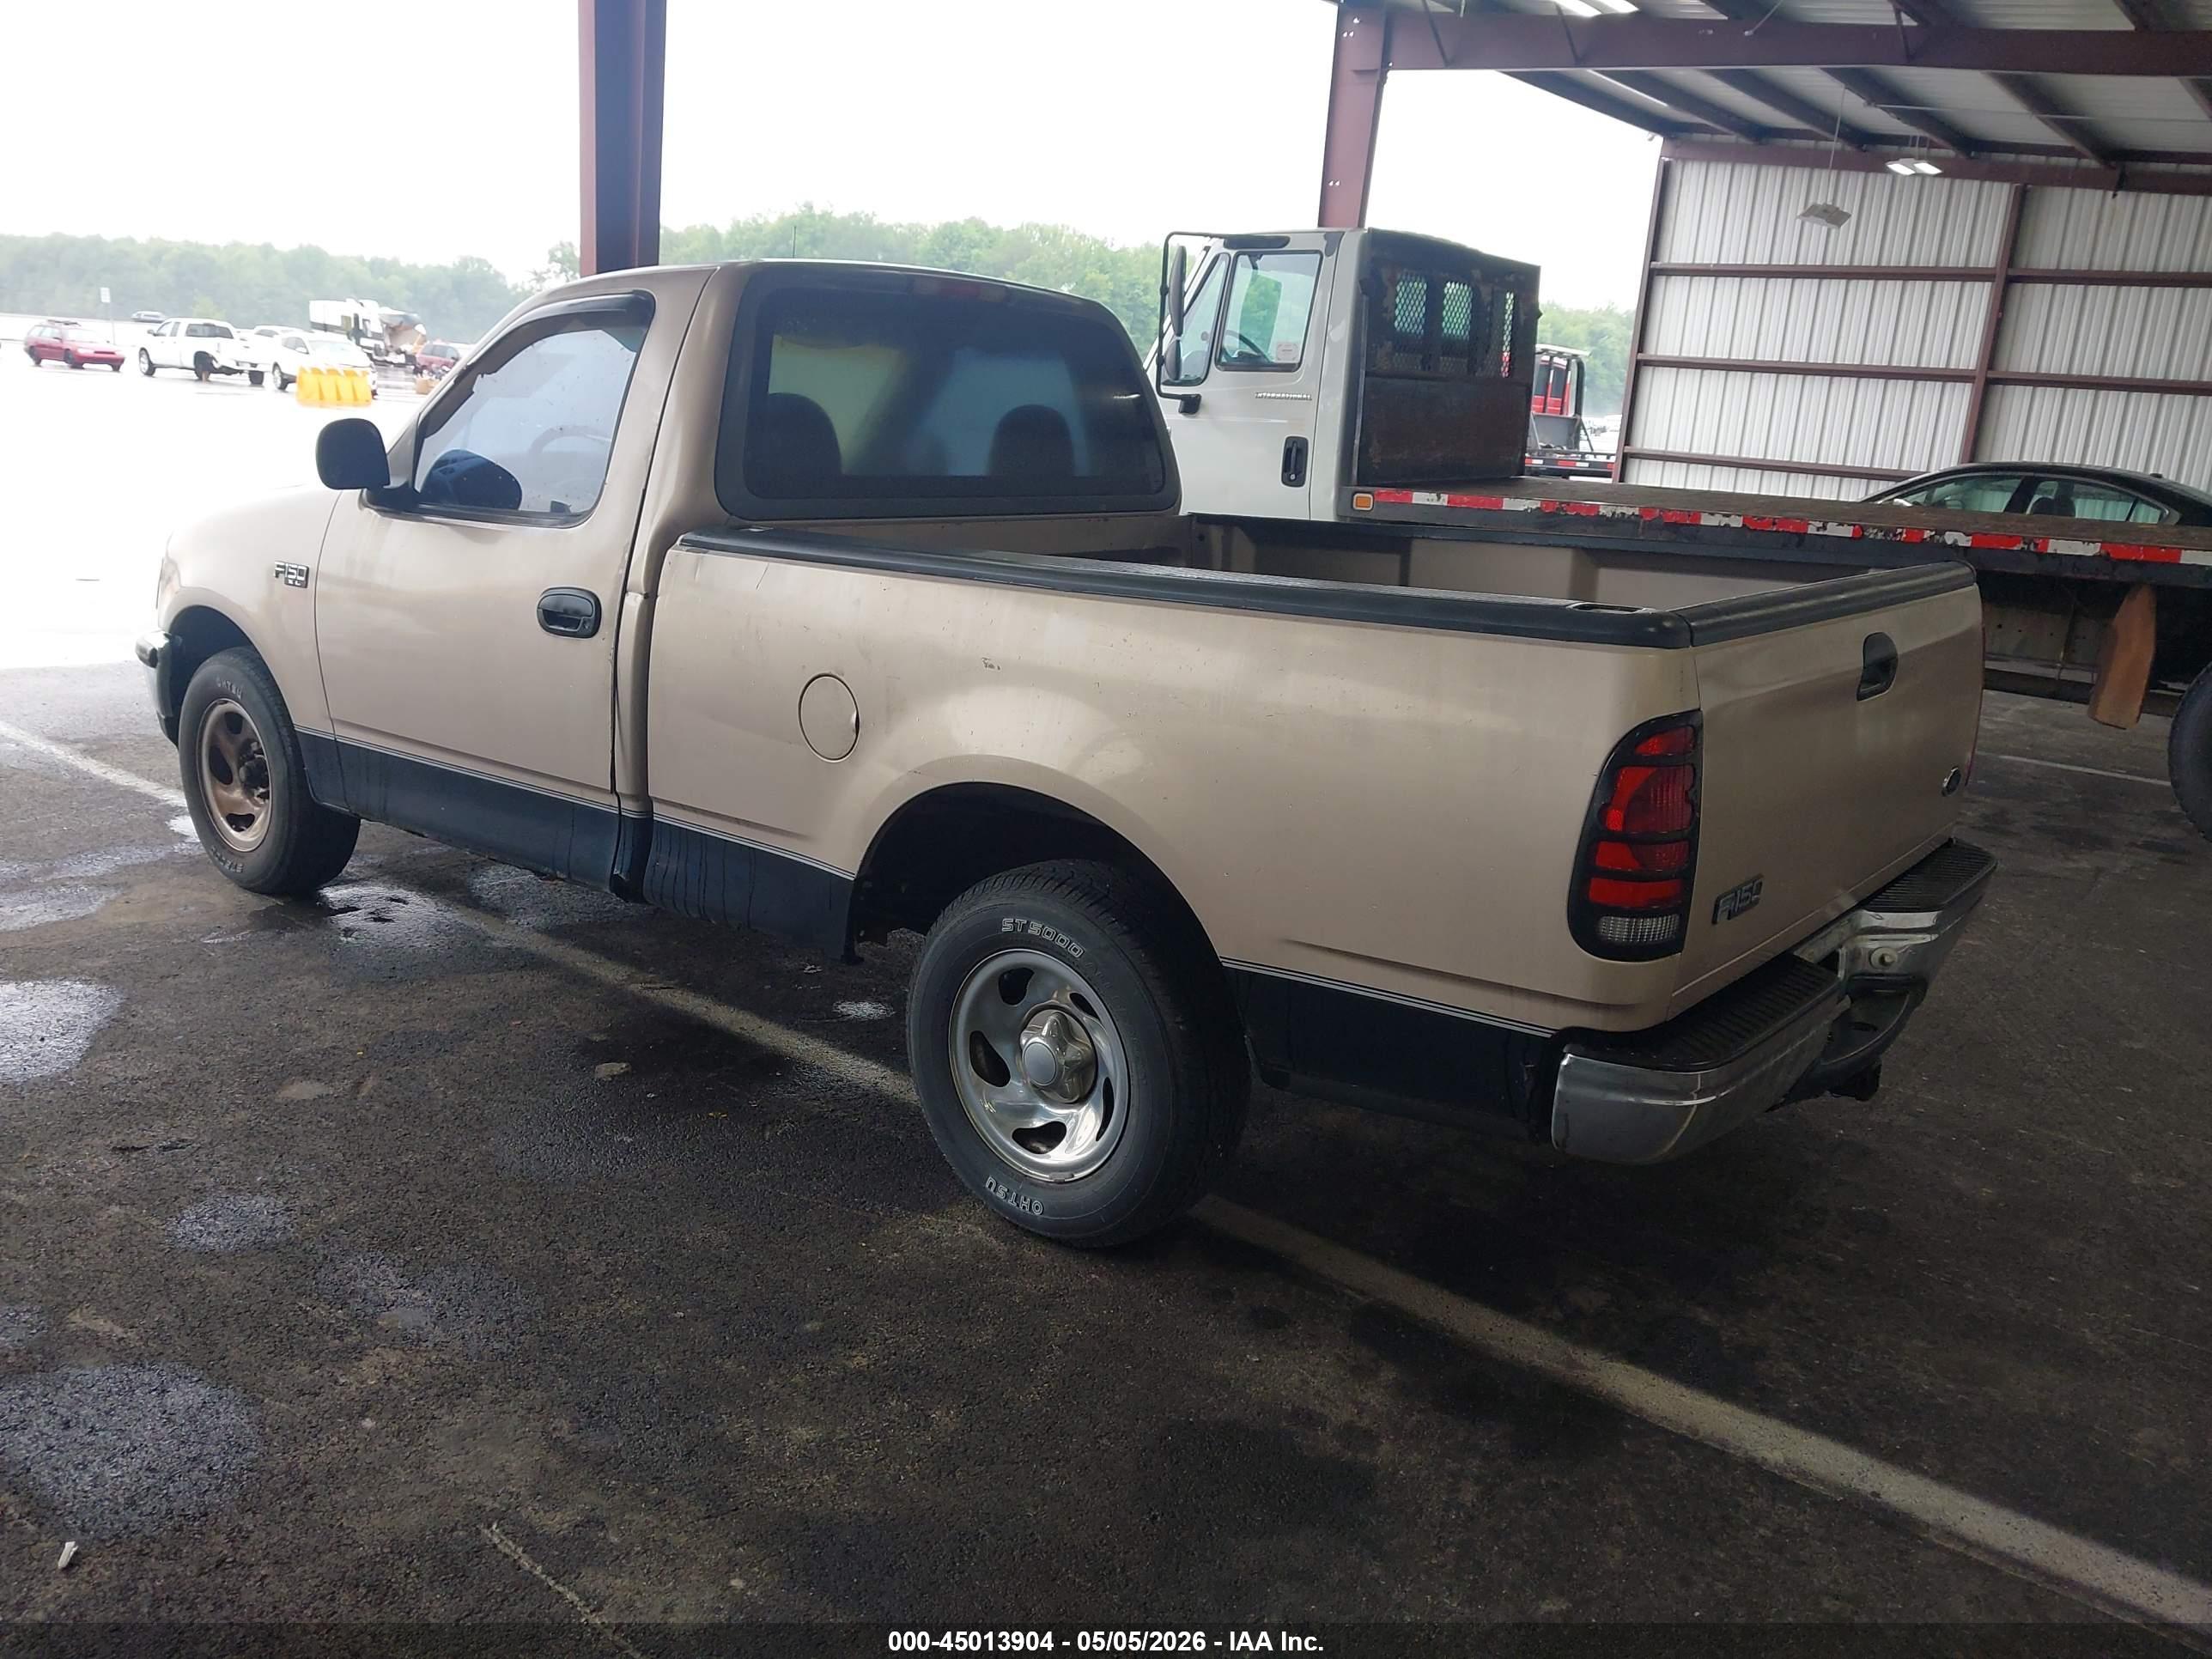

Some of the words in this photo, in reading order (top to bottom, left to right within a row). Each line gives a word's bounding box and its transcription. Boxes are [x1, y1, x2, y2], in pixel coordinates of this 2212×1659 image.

[273, 561, 307, 580] F150
[1716, 877, 1763, 922] F150
[985, 1176, 1044, 1216] OHTSU
